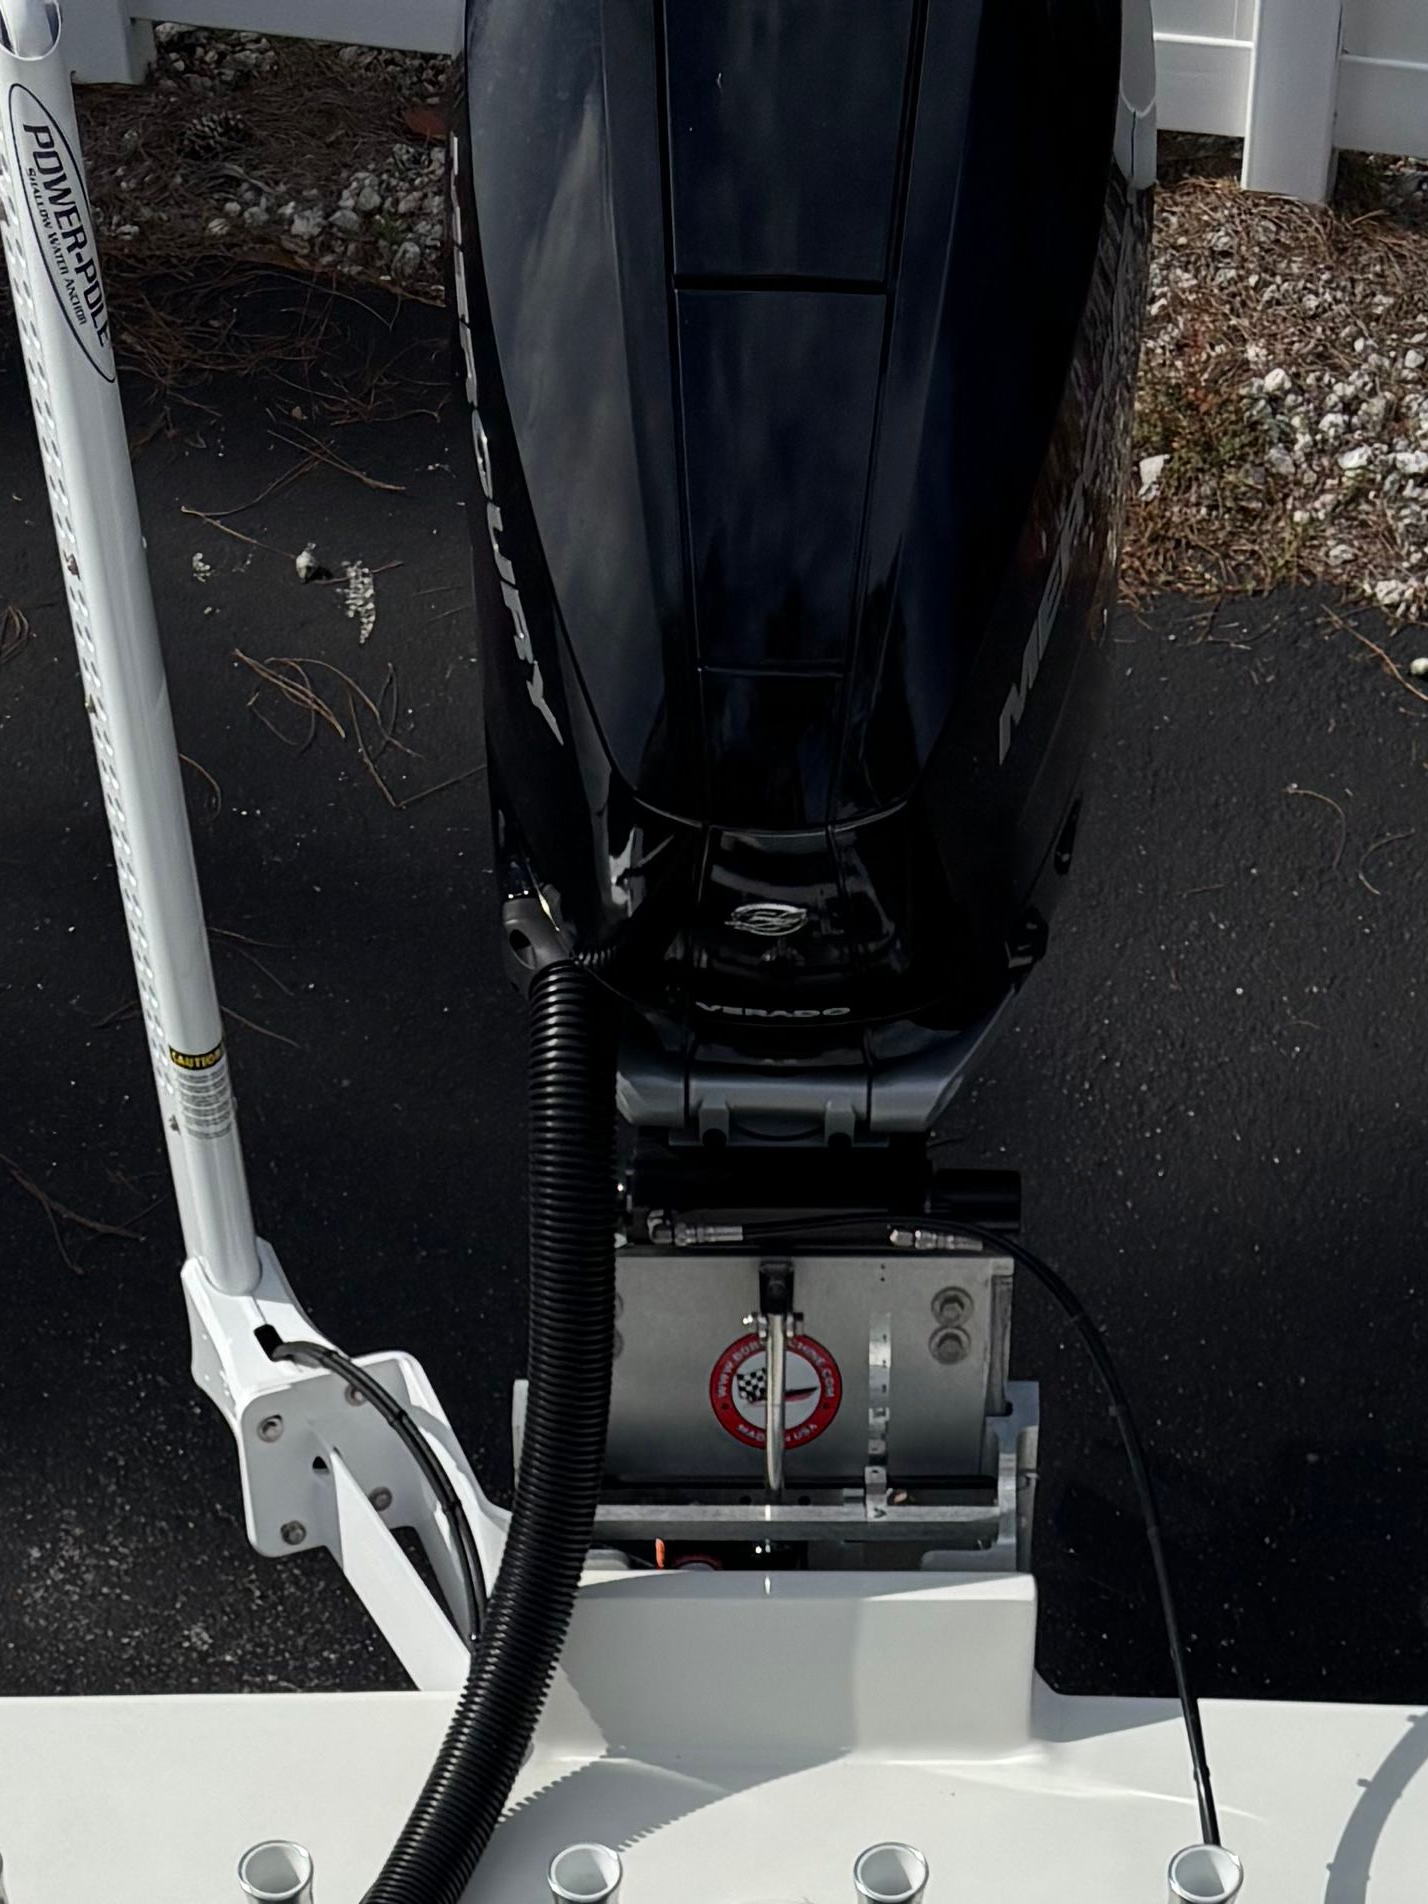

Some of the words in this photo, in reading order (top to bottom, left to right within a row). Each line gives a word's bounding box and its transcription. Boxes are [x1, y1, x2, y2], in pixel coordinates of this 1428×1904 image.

[23, 124, 111, 348] POWER-POLE
[26, 166, 53, 230] SHALLOW
[47, 230, 68, 275] WATER
[64, 275, 88, 326] ANCHOR
[695, 1000, 851, 1018] VERADO
